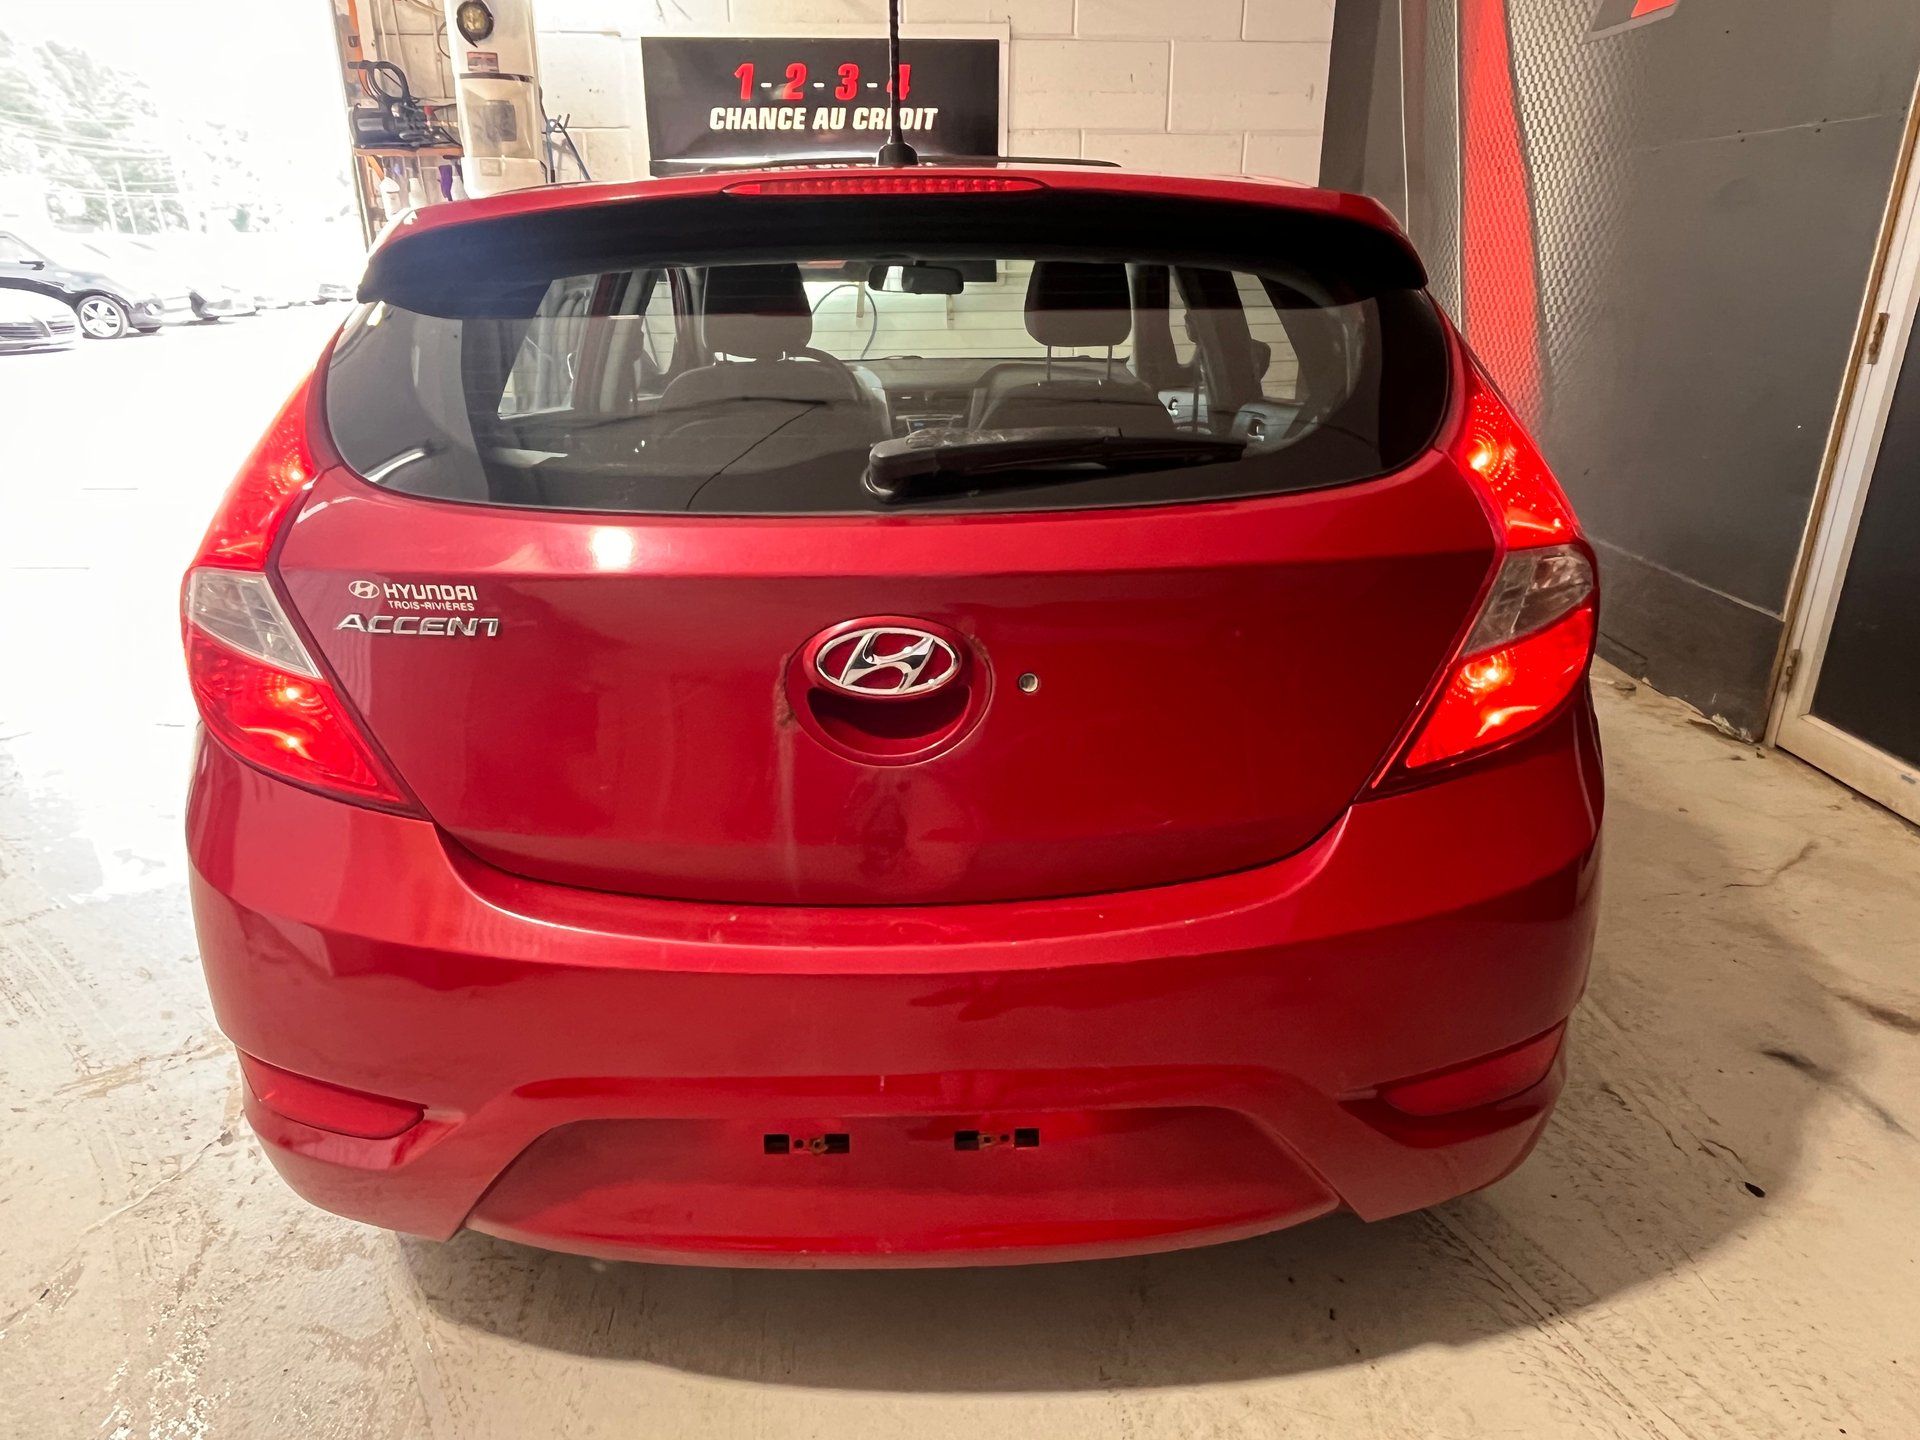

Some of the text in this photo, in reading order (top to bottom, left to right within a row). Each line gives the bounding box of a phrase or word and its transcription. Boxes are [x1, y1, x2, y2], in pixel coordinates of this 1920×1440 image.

[709, 107, 807, 130] CHANCE
[812, 107, 847, 130] AU
[383, 582, 478, 601] HYUNDAI
[387, 600, 475, 612] TROIS-RIVIÈRES
[335, 613, 499, 637] ACCENT
